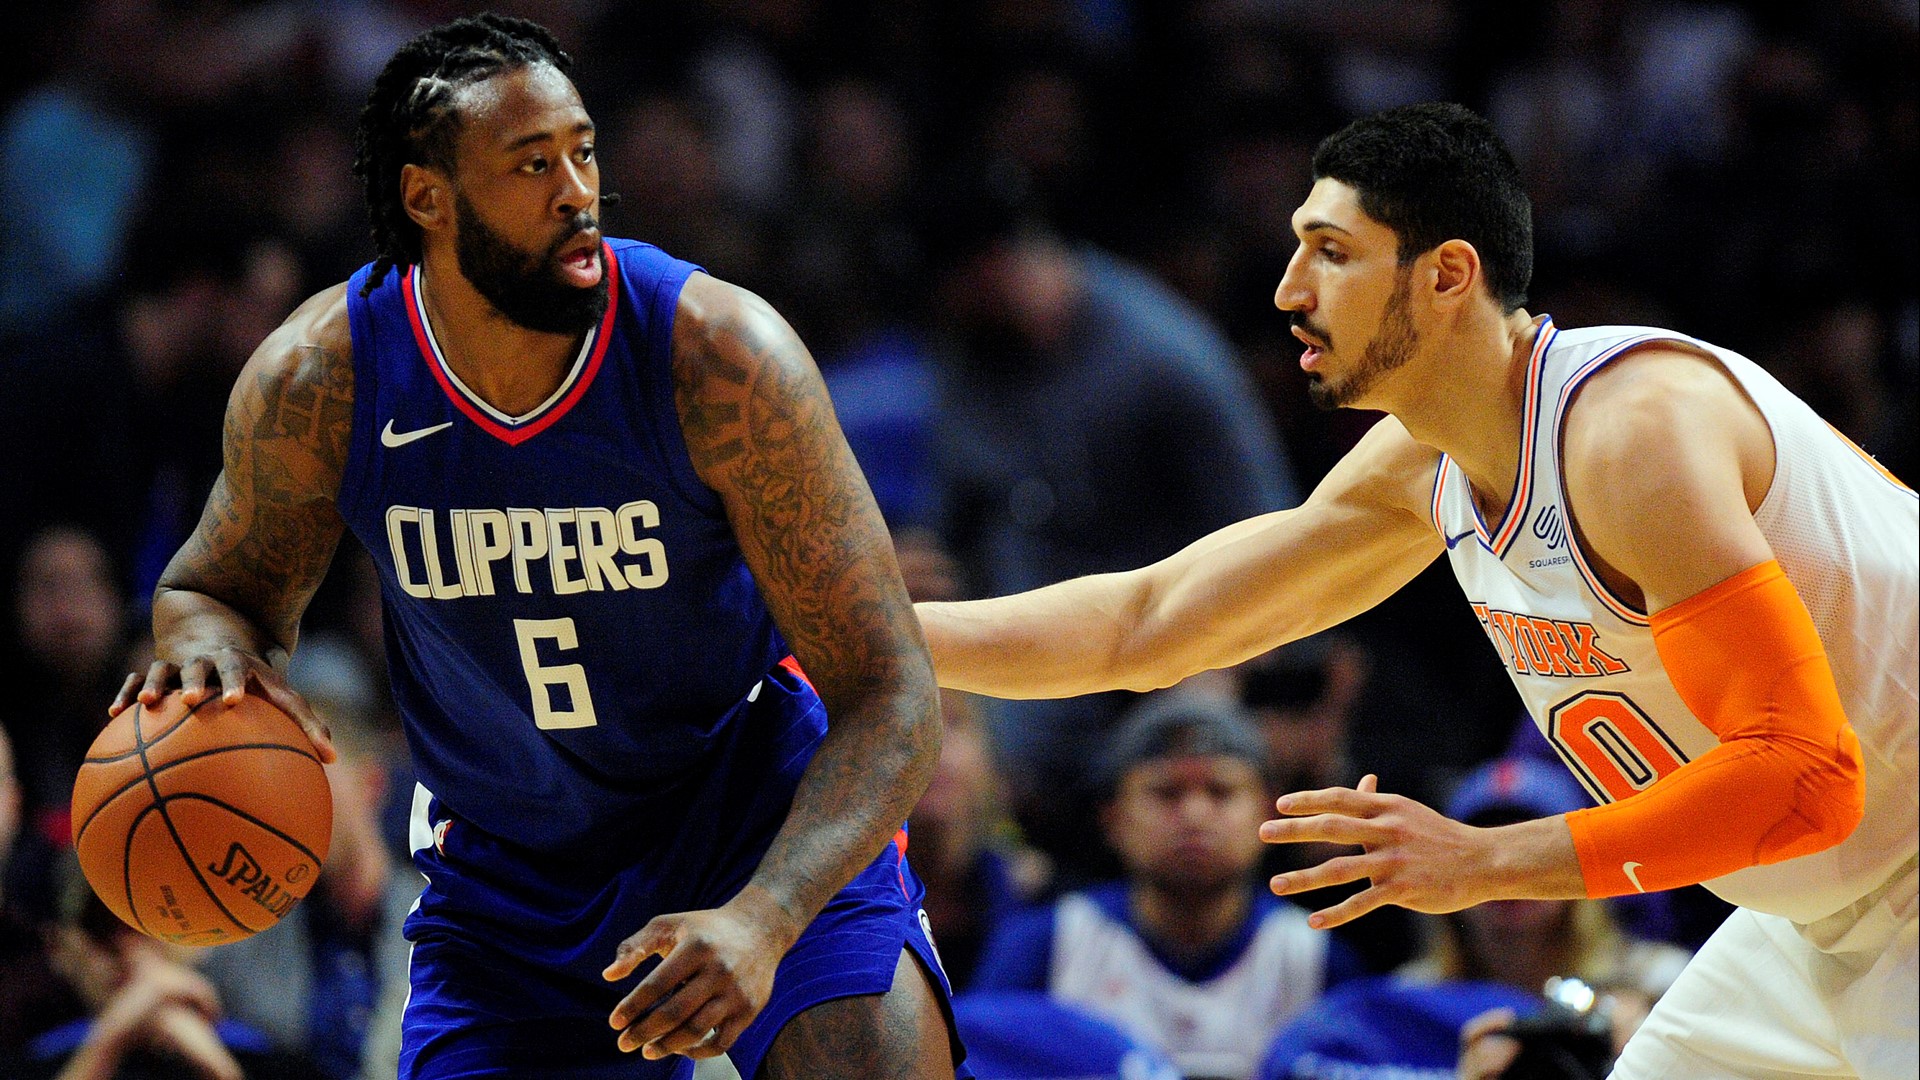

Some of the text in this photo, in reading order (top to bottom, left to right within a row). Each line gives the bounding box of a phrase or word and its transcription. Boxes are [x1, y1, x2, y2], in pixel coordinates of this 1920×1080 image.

[386, 500, 669, 600] CLIPPERS
[1529, 555, 1570, 569] SQUARESP
[513, 617, 597, 730] 6
[1490, 609, 1631, 678] YORK
[1548, 689, 1691, 806] 0
